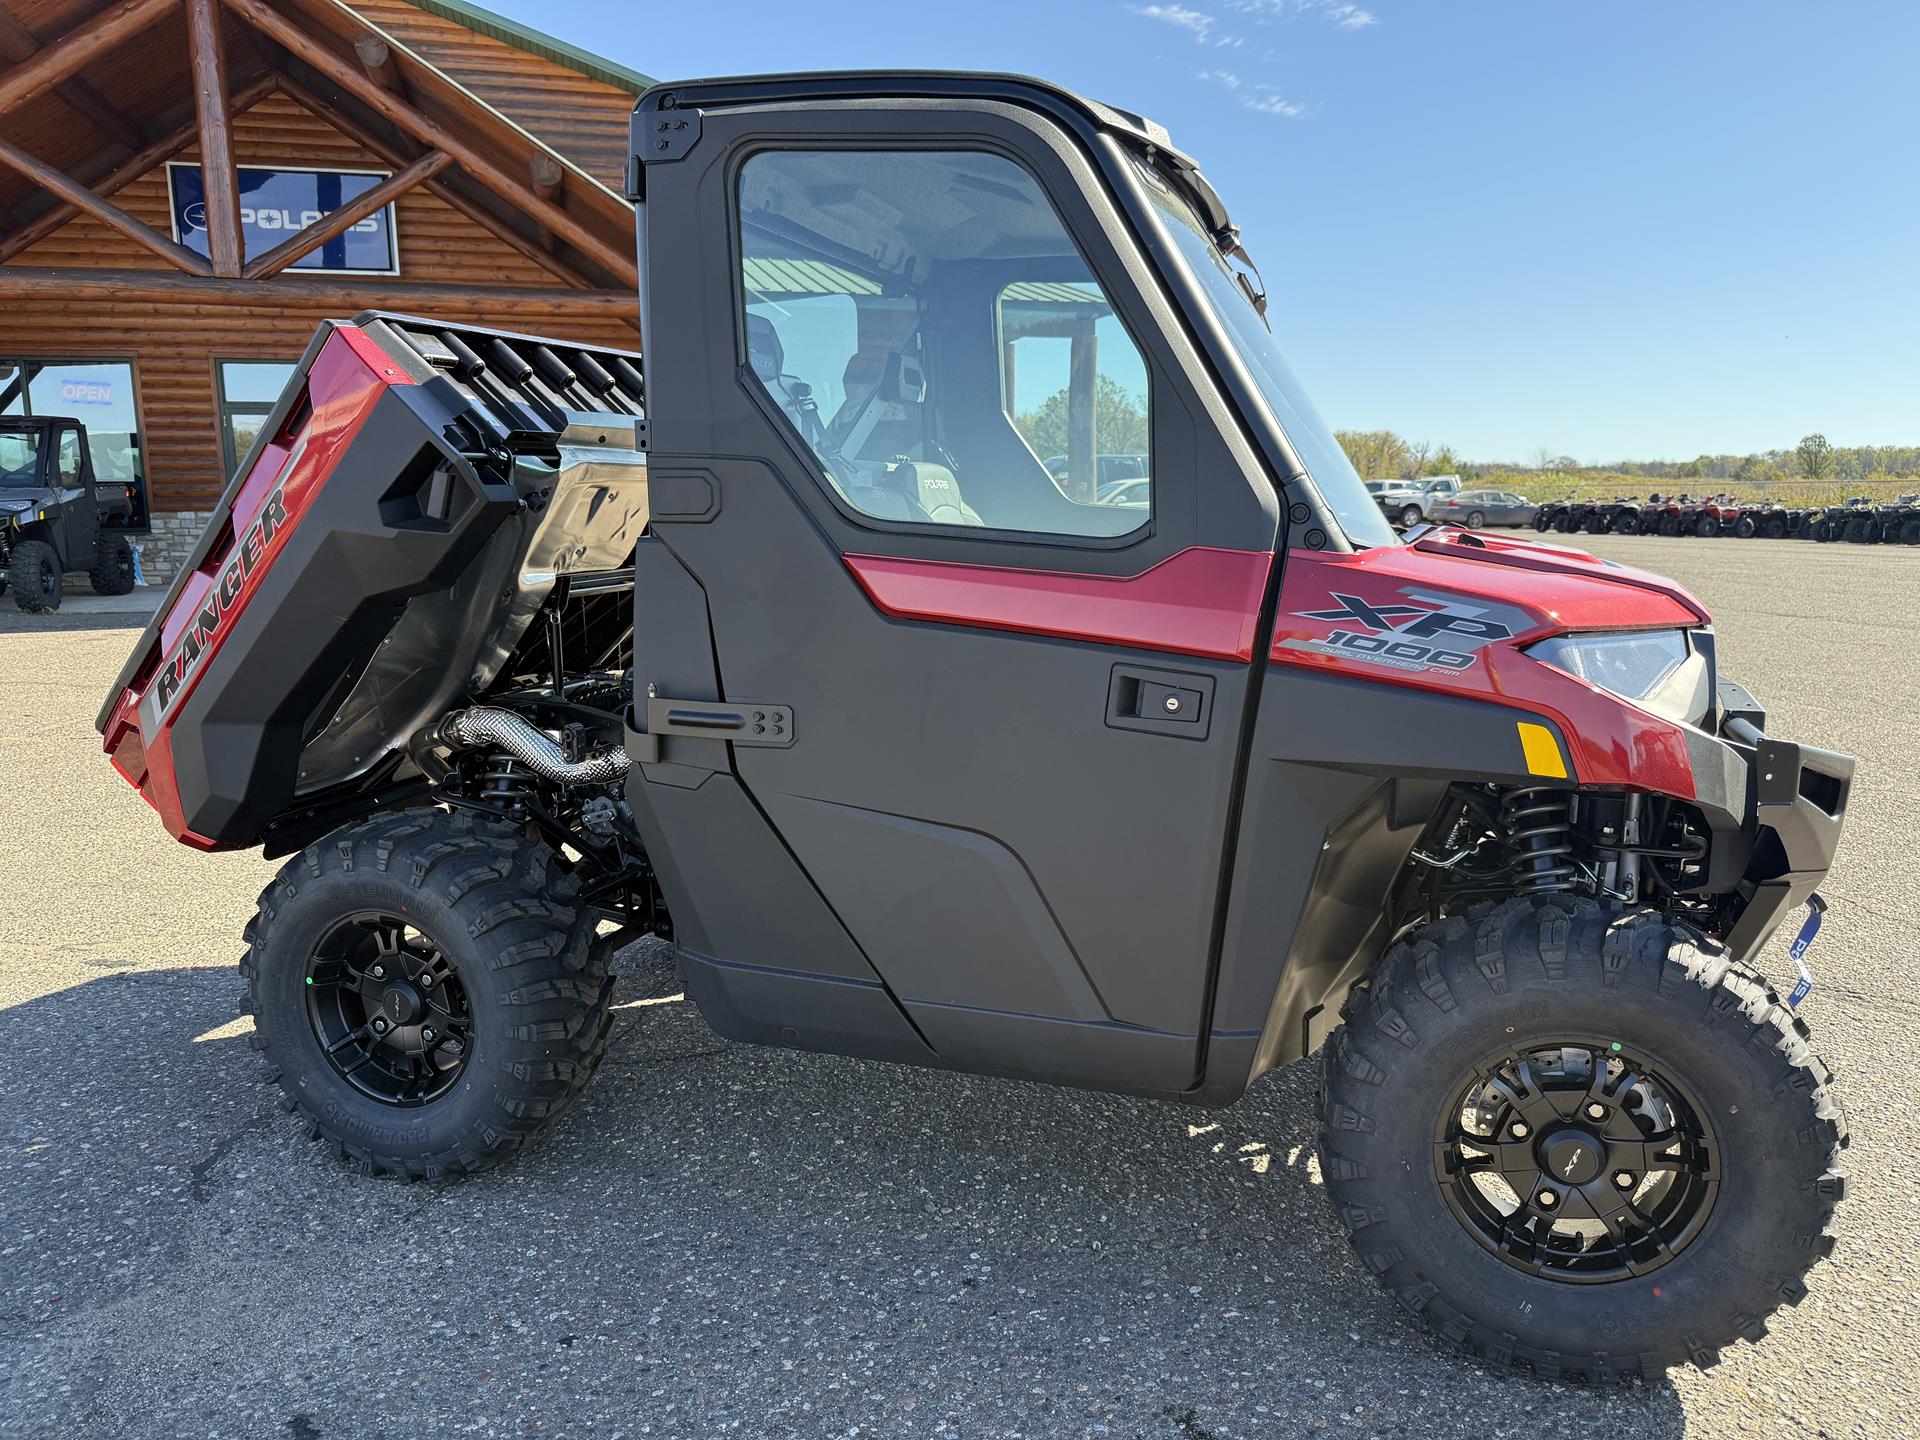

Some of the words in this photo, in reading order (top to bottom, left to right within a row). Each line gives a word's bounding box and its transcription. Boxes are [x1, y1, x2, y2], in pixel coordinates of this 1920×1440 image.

[240, 207, 379, 233] POLAS
[62, 384, 111, 401] OPEN
[154, 487, 288, 714] RANGER
[1288, 591, 1514, 642] XP
[1320, 629, 1477, 671] 1000
[1320, 646, 1354, 657] DUAL
[1356, 653, 1429, 671] OVERHEAD
[1430, 667, 1462, 677] CAM
